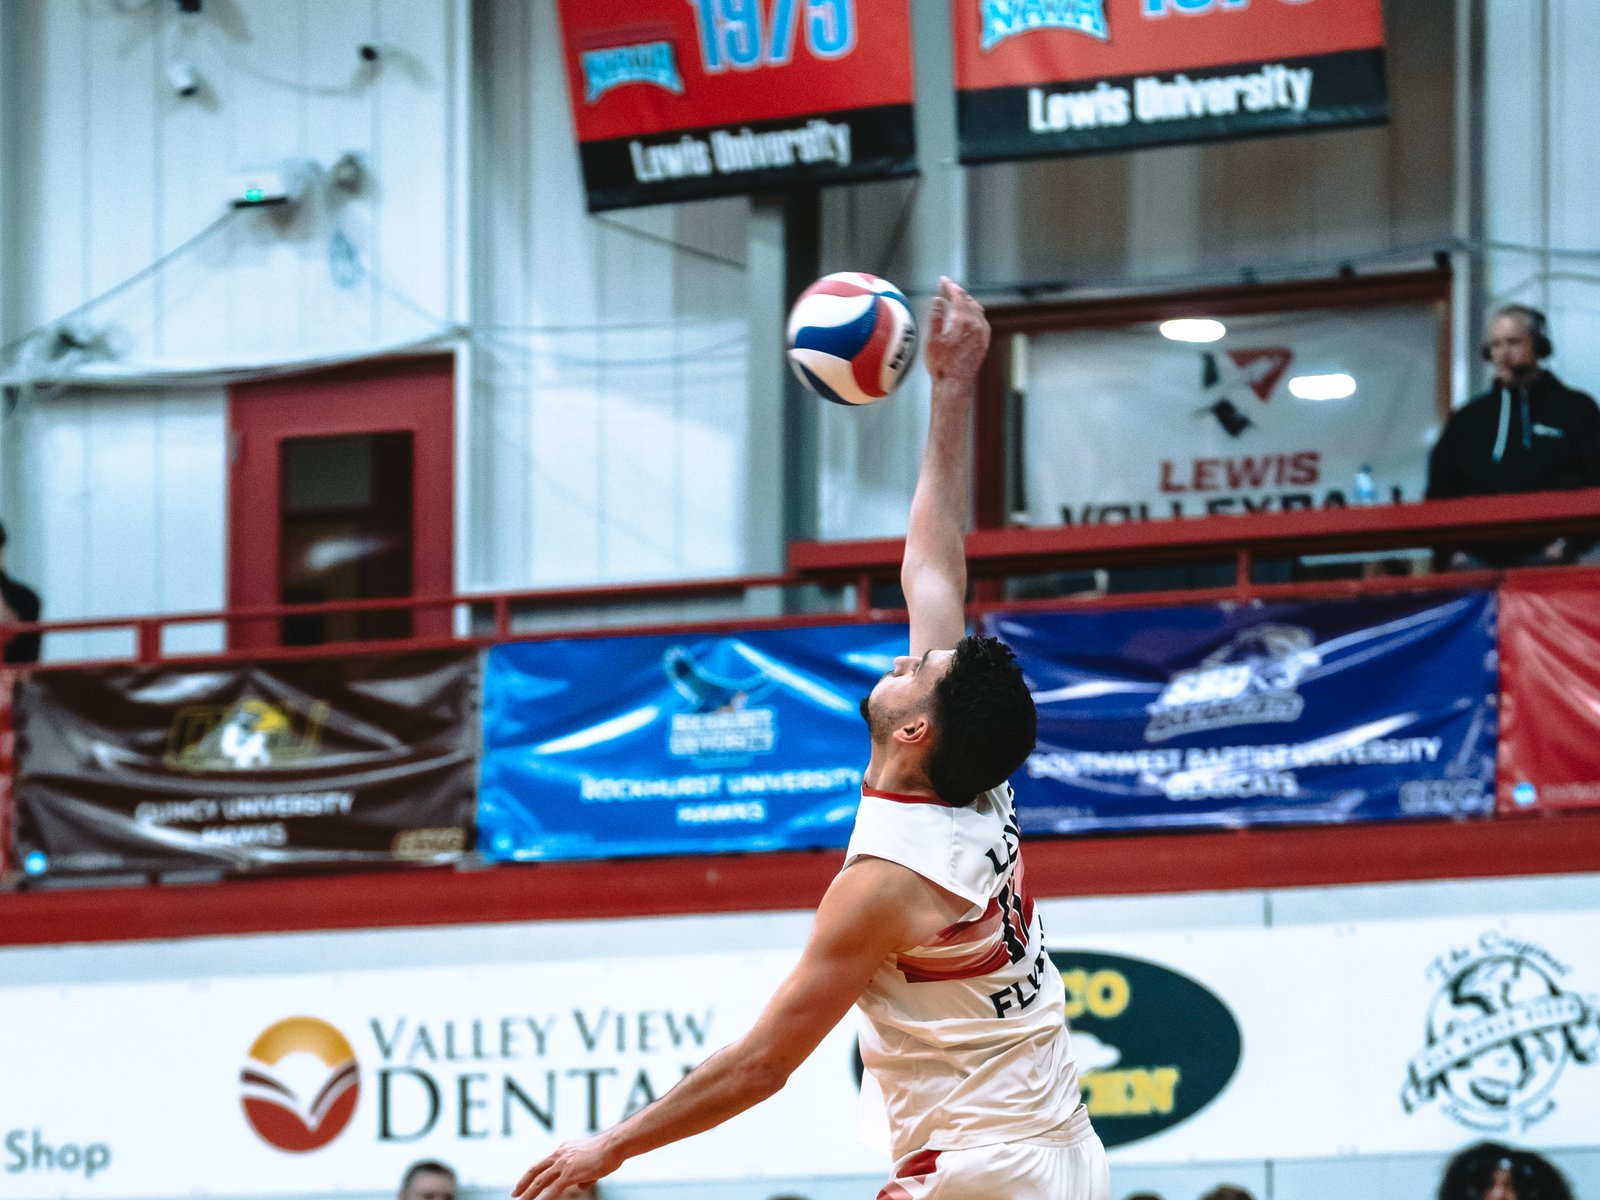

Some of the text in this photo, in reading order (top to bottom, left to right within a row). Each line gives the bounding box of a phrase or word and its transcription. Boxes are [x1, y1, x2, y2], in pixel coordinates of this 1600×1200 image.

[1028, 64, 1313, 133] Lewis University
[629, 119, 851, 182] Lewis University
[1159, 451, 1322, 494] LEWIS
[370, 1007, 714, 1062] VALLEY VIEW
[377, 1065, 695, 1143] DENTA
[4, 1127, 112, 1180] Shop
